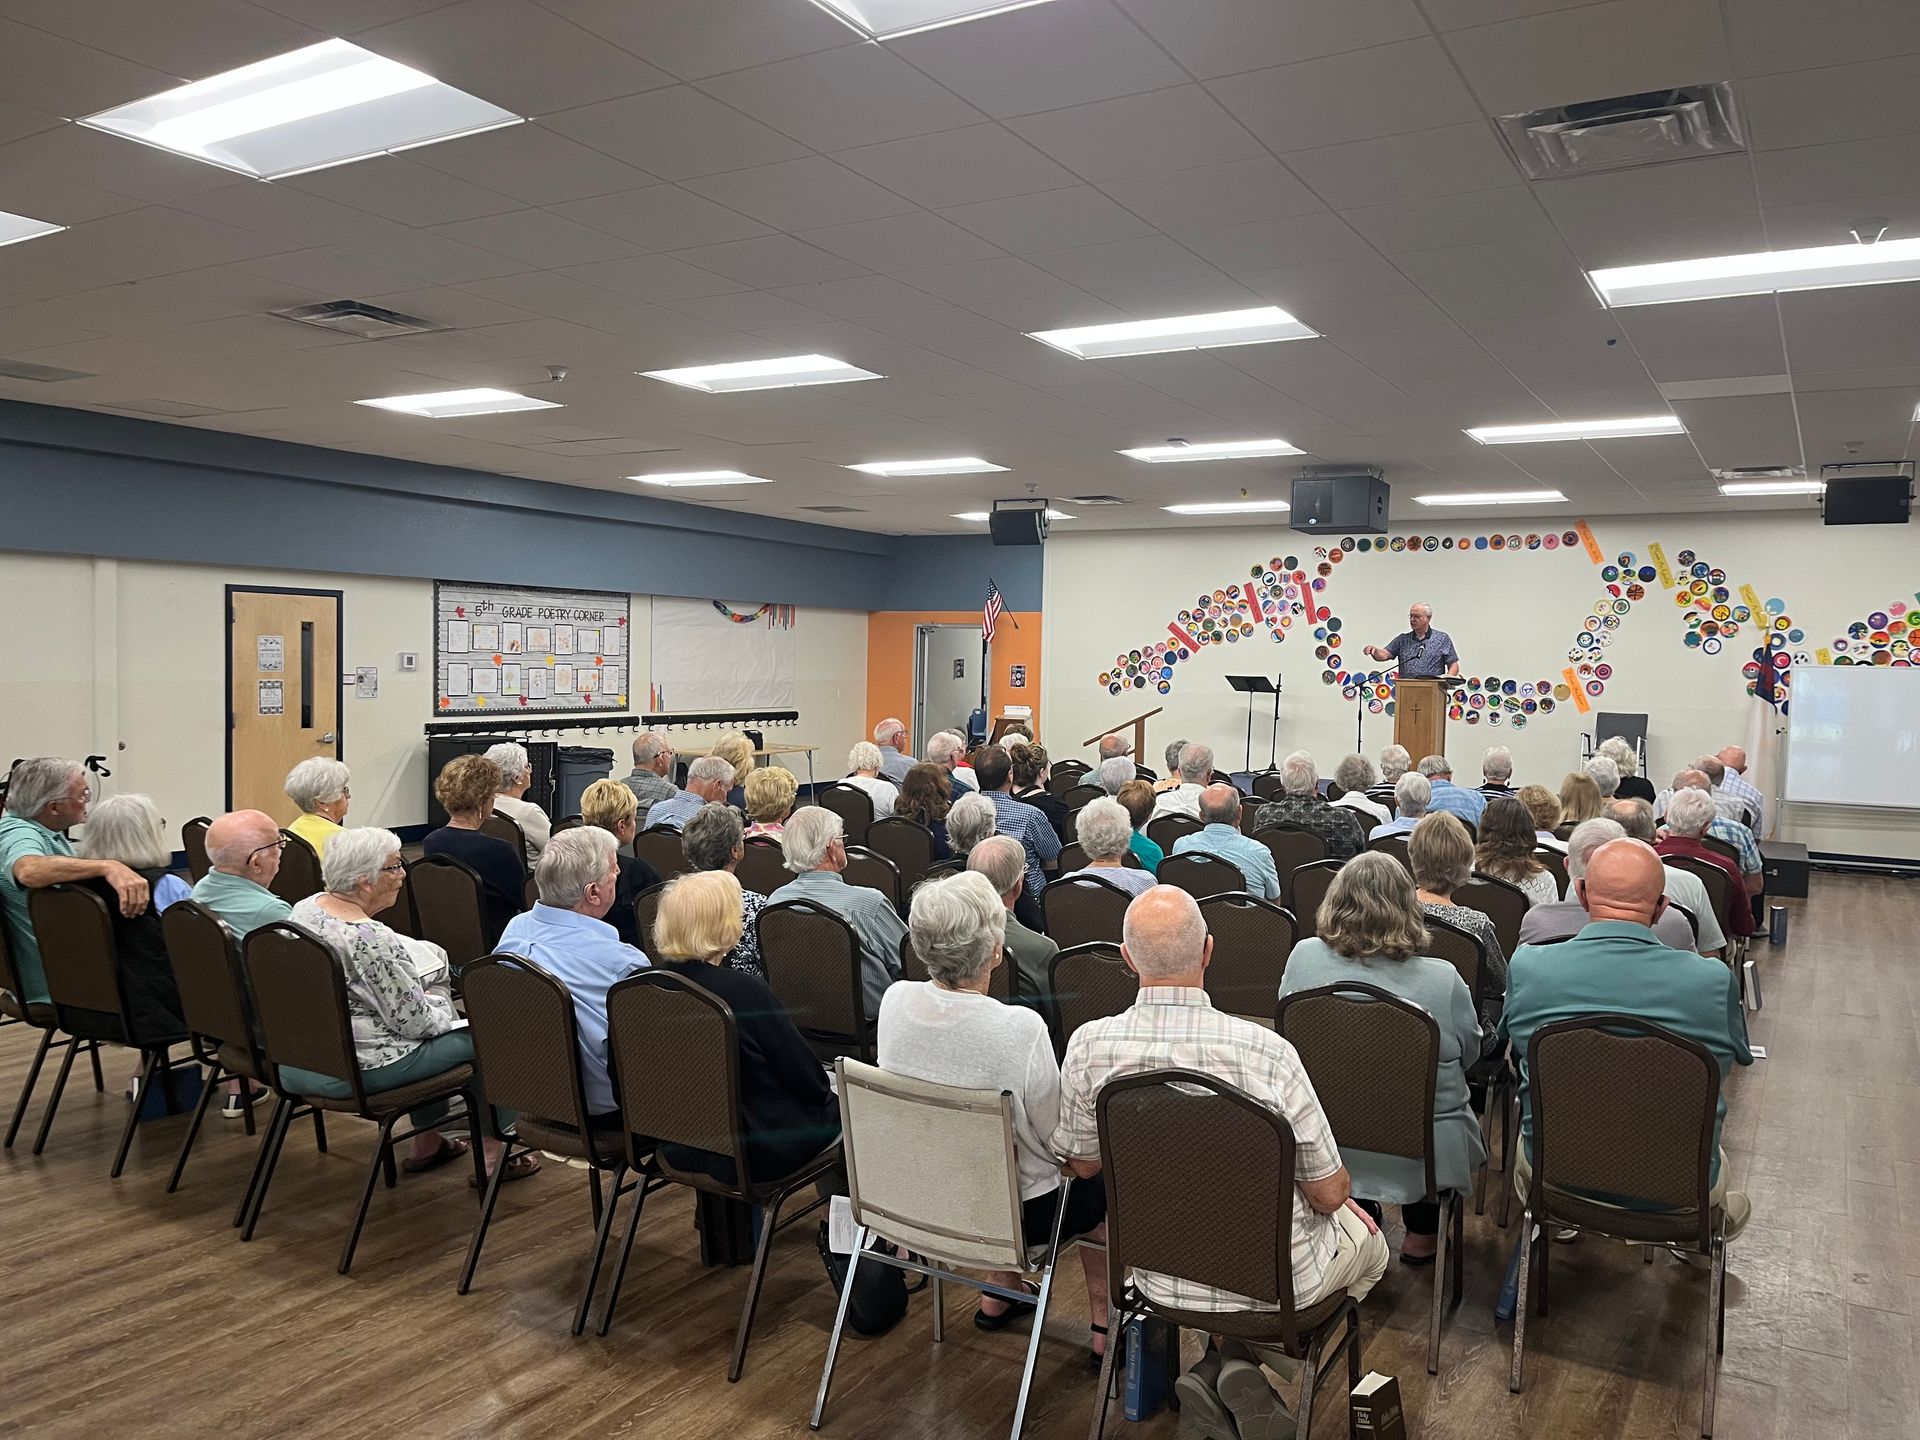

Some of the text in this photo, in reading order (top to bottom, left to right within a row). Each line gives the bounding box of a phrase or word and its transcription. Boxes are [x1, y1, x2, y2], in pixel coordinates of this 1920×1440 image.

[475, 600, 605, 622] 5th GRADE POETRY CORNER
